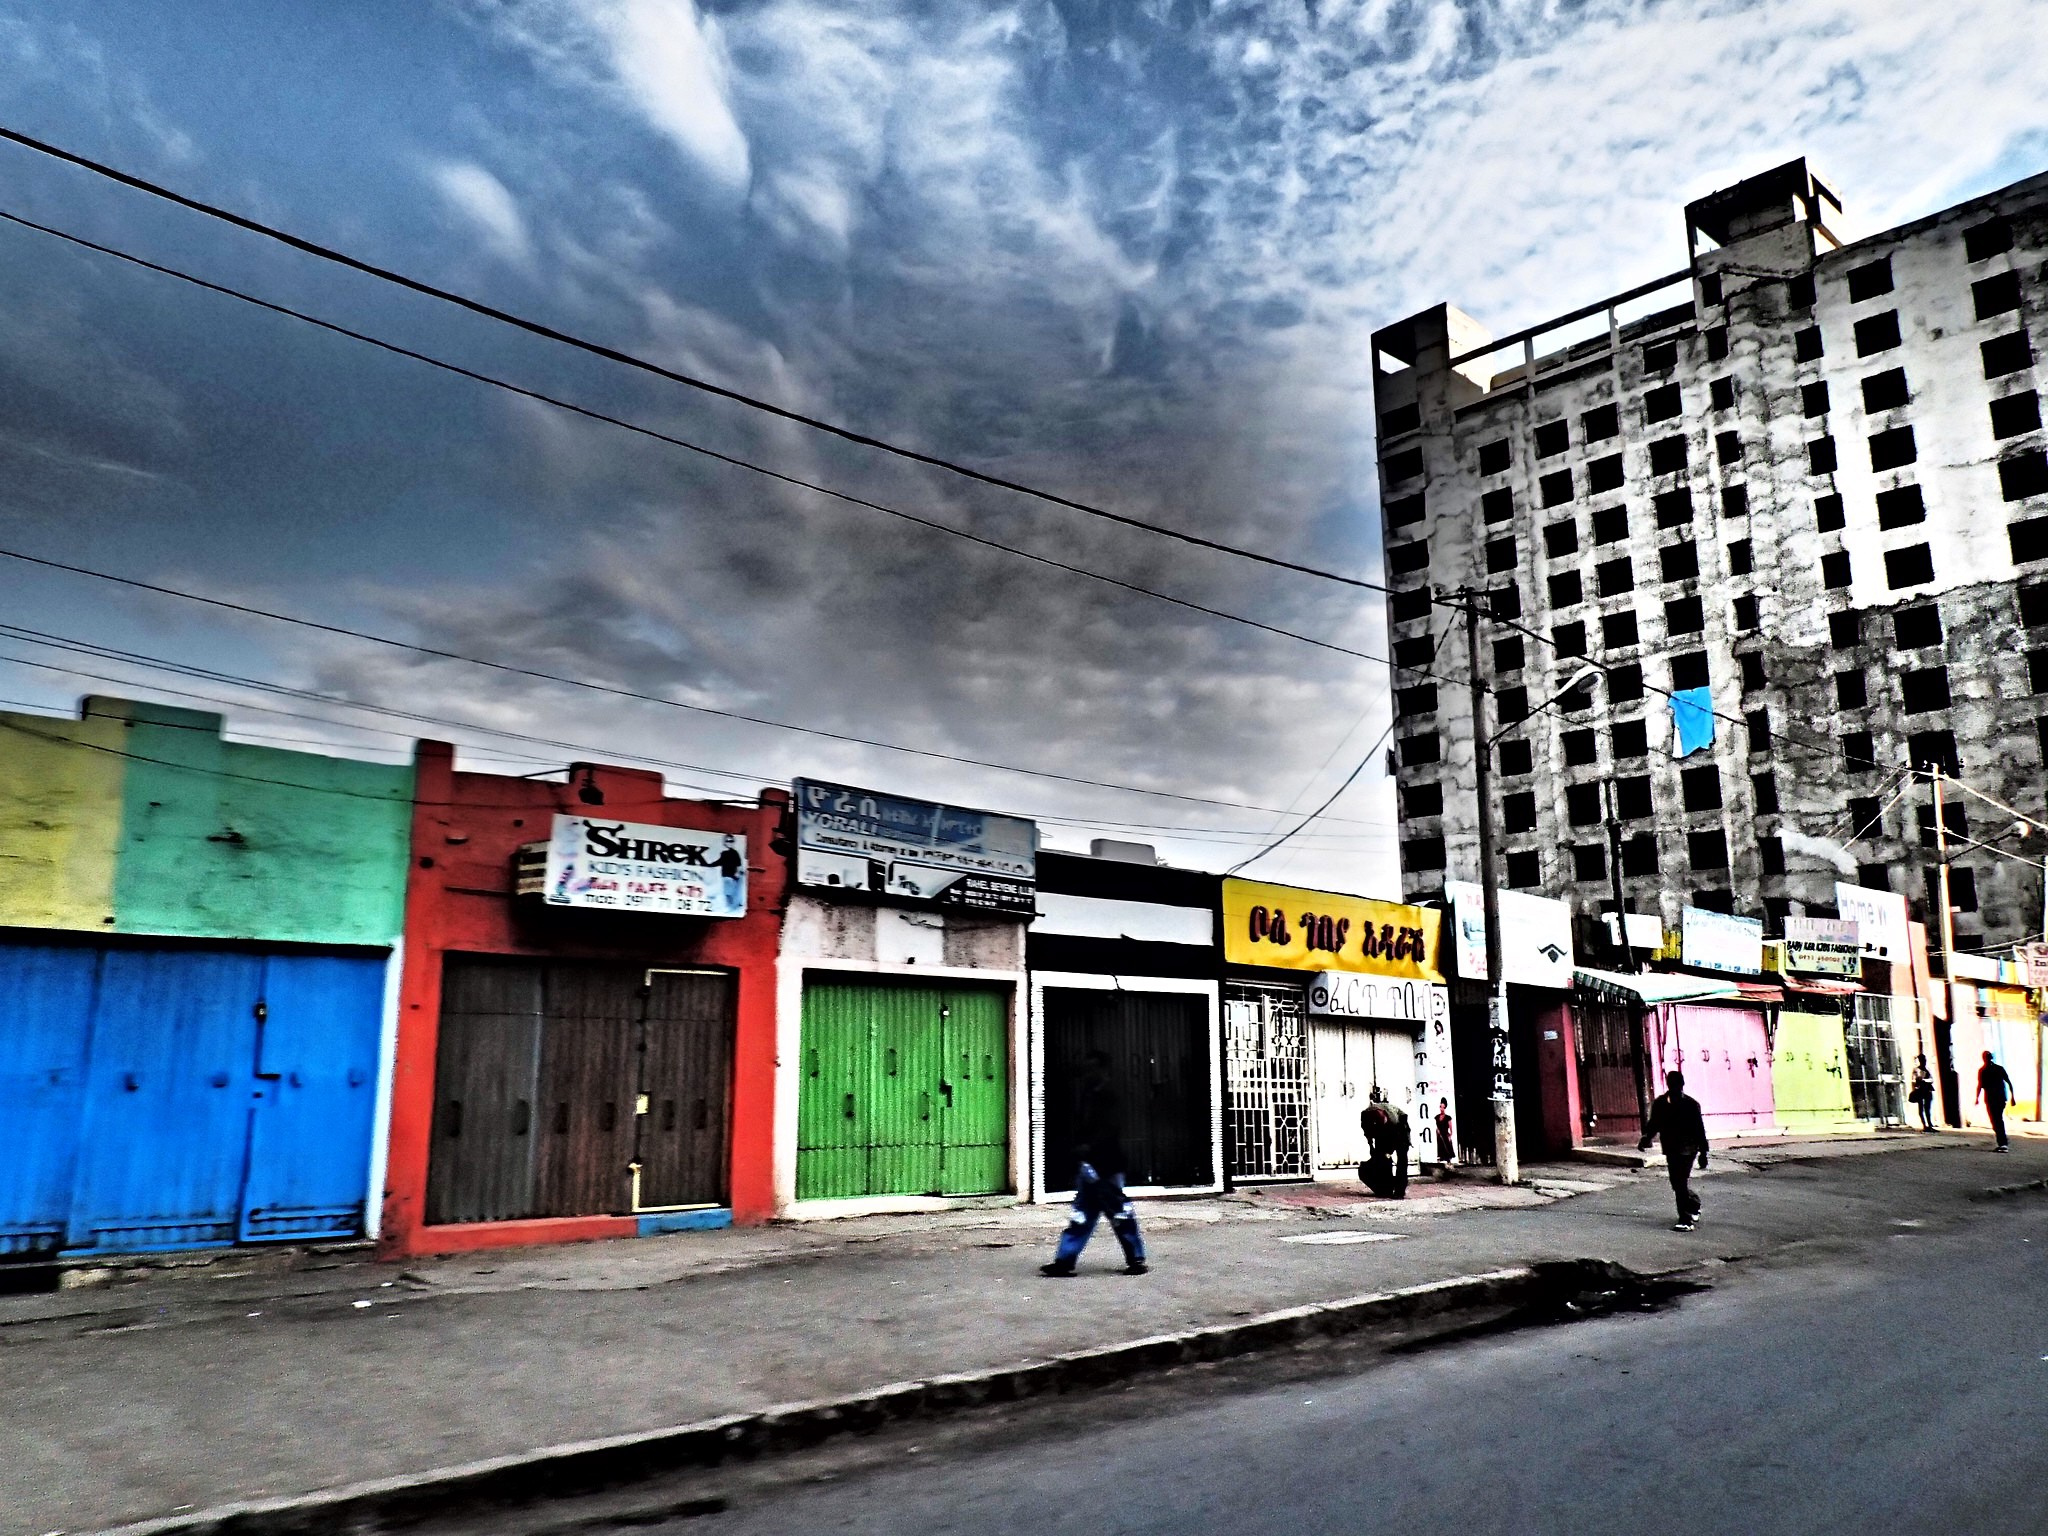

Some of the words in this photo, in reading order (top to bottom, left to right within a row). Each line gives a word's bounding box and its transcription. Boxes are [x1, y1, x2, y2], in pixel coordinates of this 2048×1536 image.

[803, 811, 878, 836] YORALI
[637, 864, 704, 881] FASHION
[1786, 940, 1803, 952] BABY
